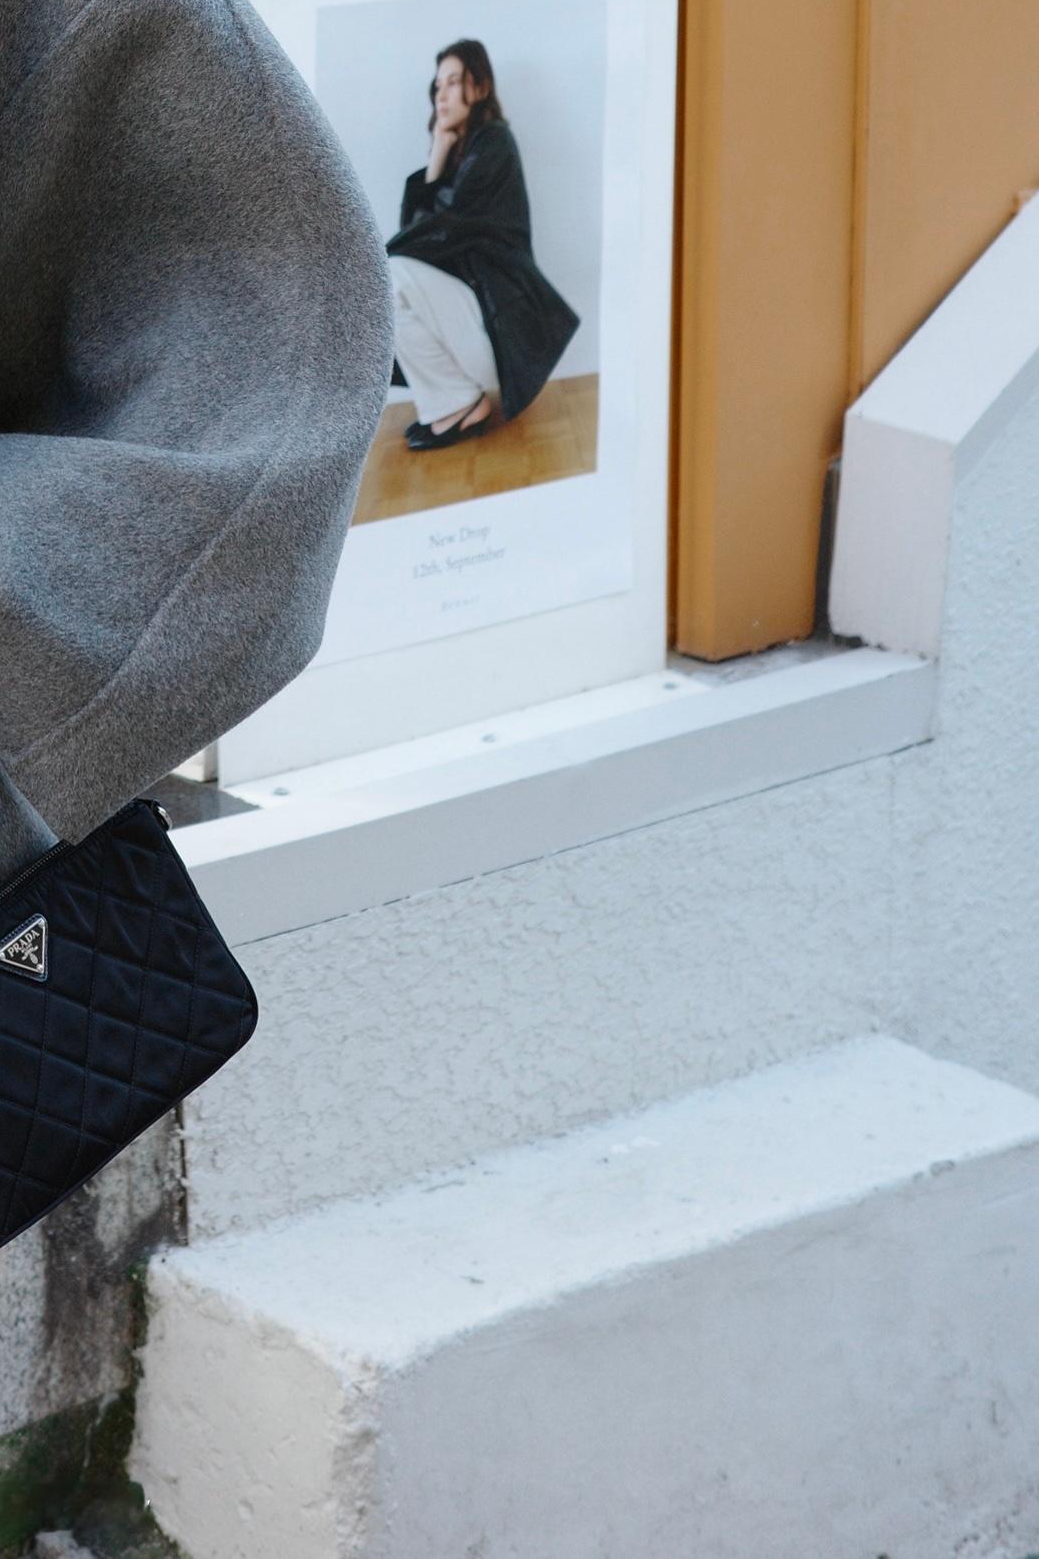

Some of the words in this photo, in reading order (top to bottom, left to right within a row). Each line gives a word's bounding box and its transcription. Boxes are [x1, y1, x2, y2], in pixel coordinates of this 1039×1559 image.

[428, 532, 456, 549] New
[459, 525, 491, 543] Drop
[445, 546, 506, 573] September
[8, 930, 40, 957] PRADA
